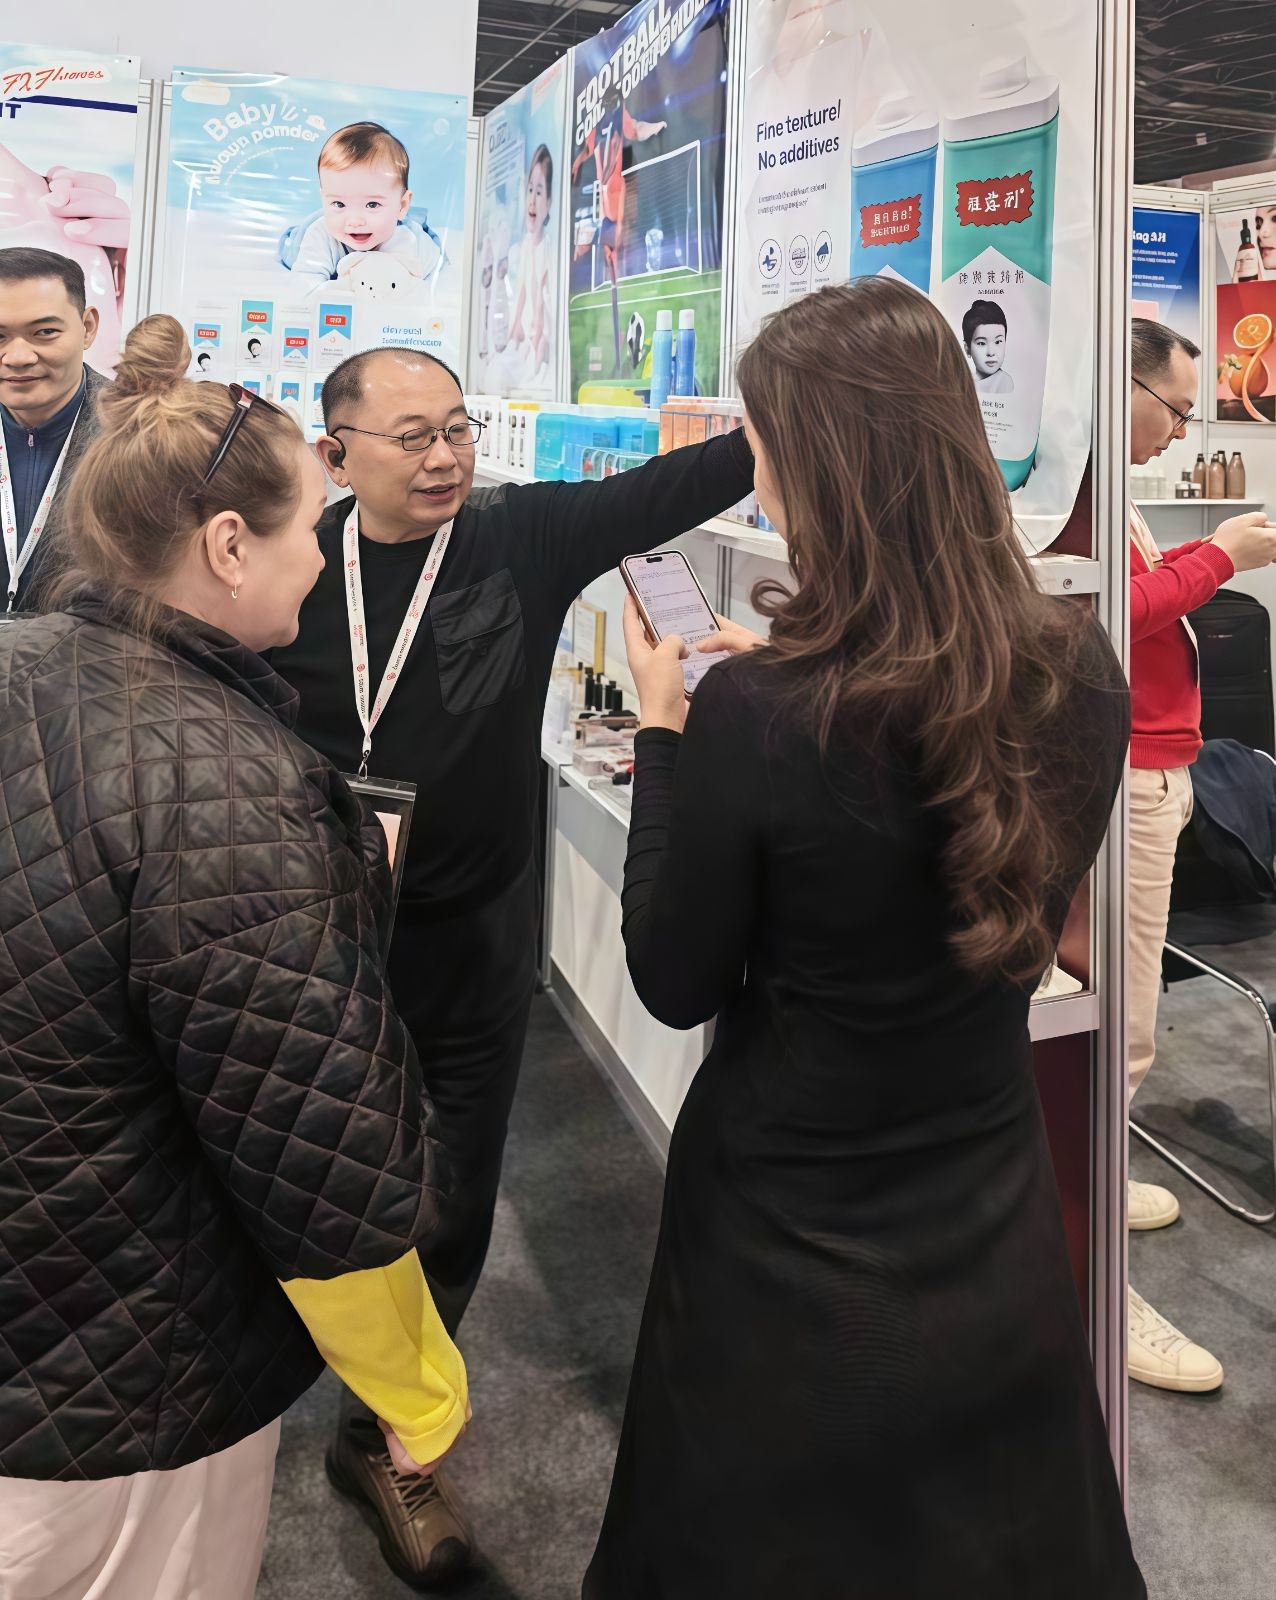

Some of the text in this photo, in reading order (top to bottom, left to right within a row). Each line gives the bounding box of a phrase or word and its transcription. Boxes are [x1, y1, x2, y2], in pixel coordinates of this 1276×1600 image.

[576, 0, 672, 125] FOOTBALL
[202, 102, 277, 142] Baby
[756, 121, 784, 142] Fine
[758, 136, 839, 171] No additives
